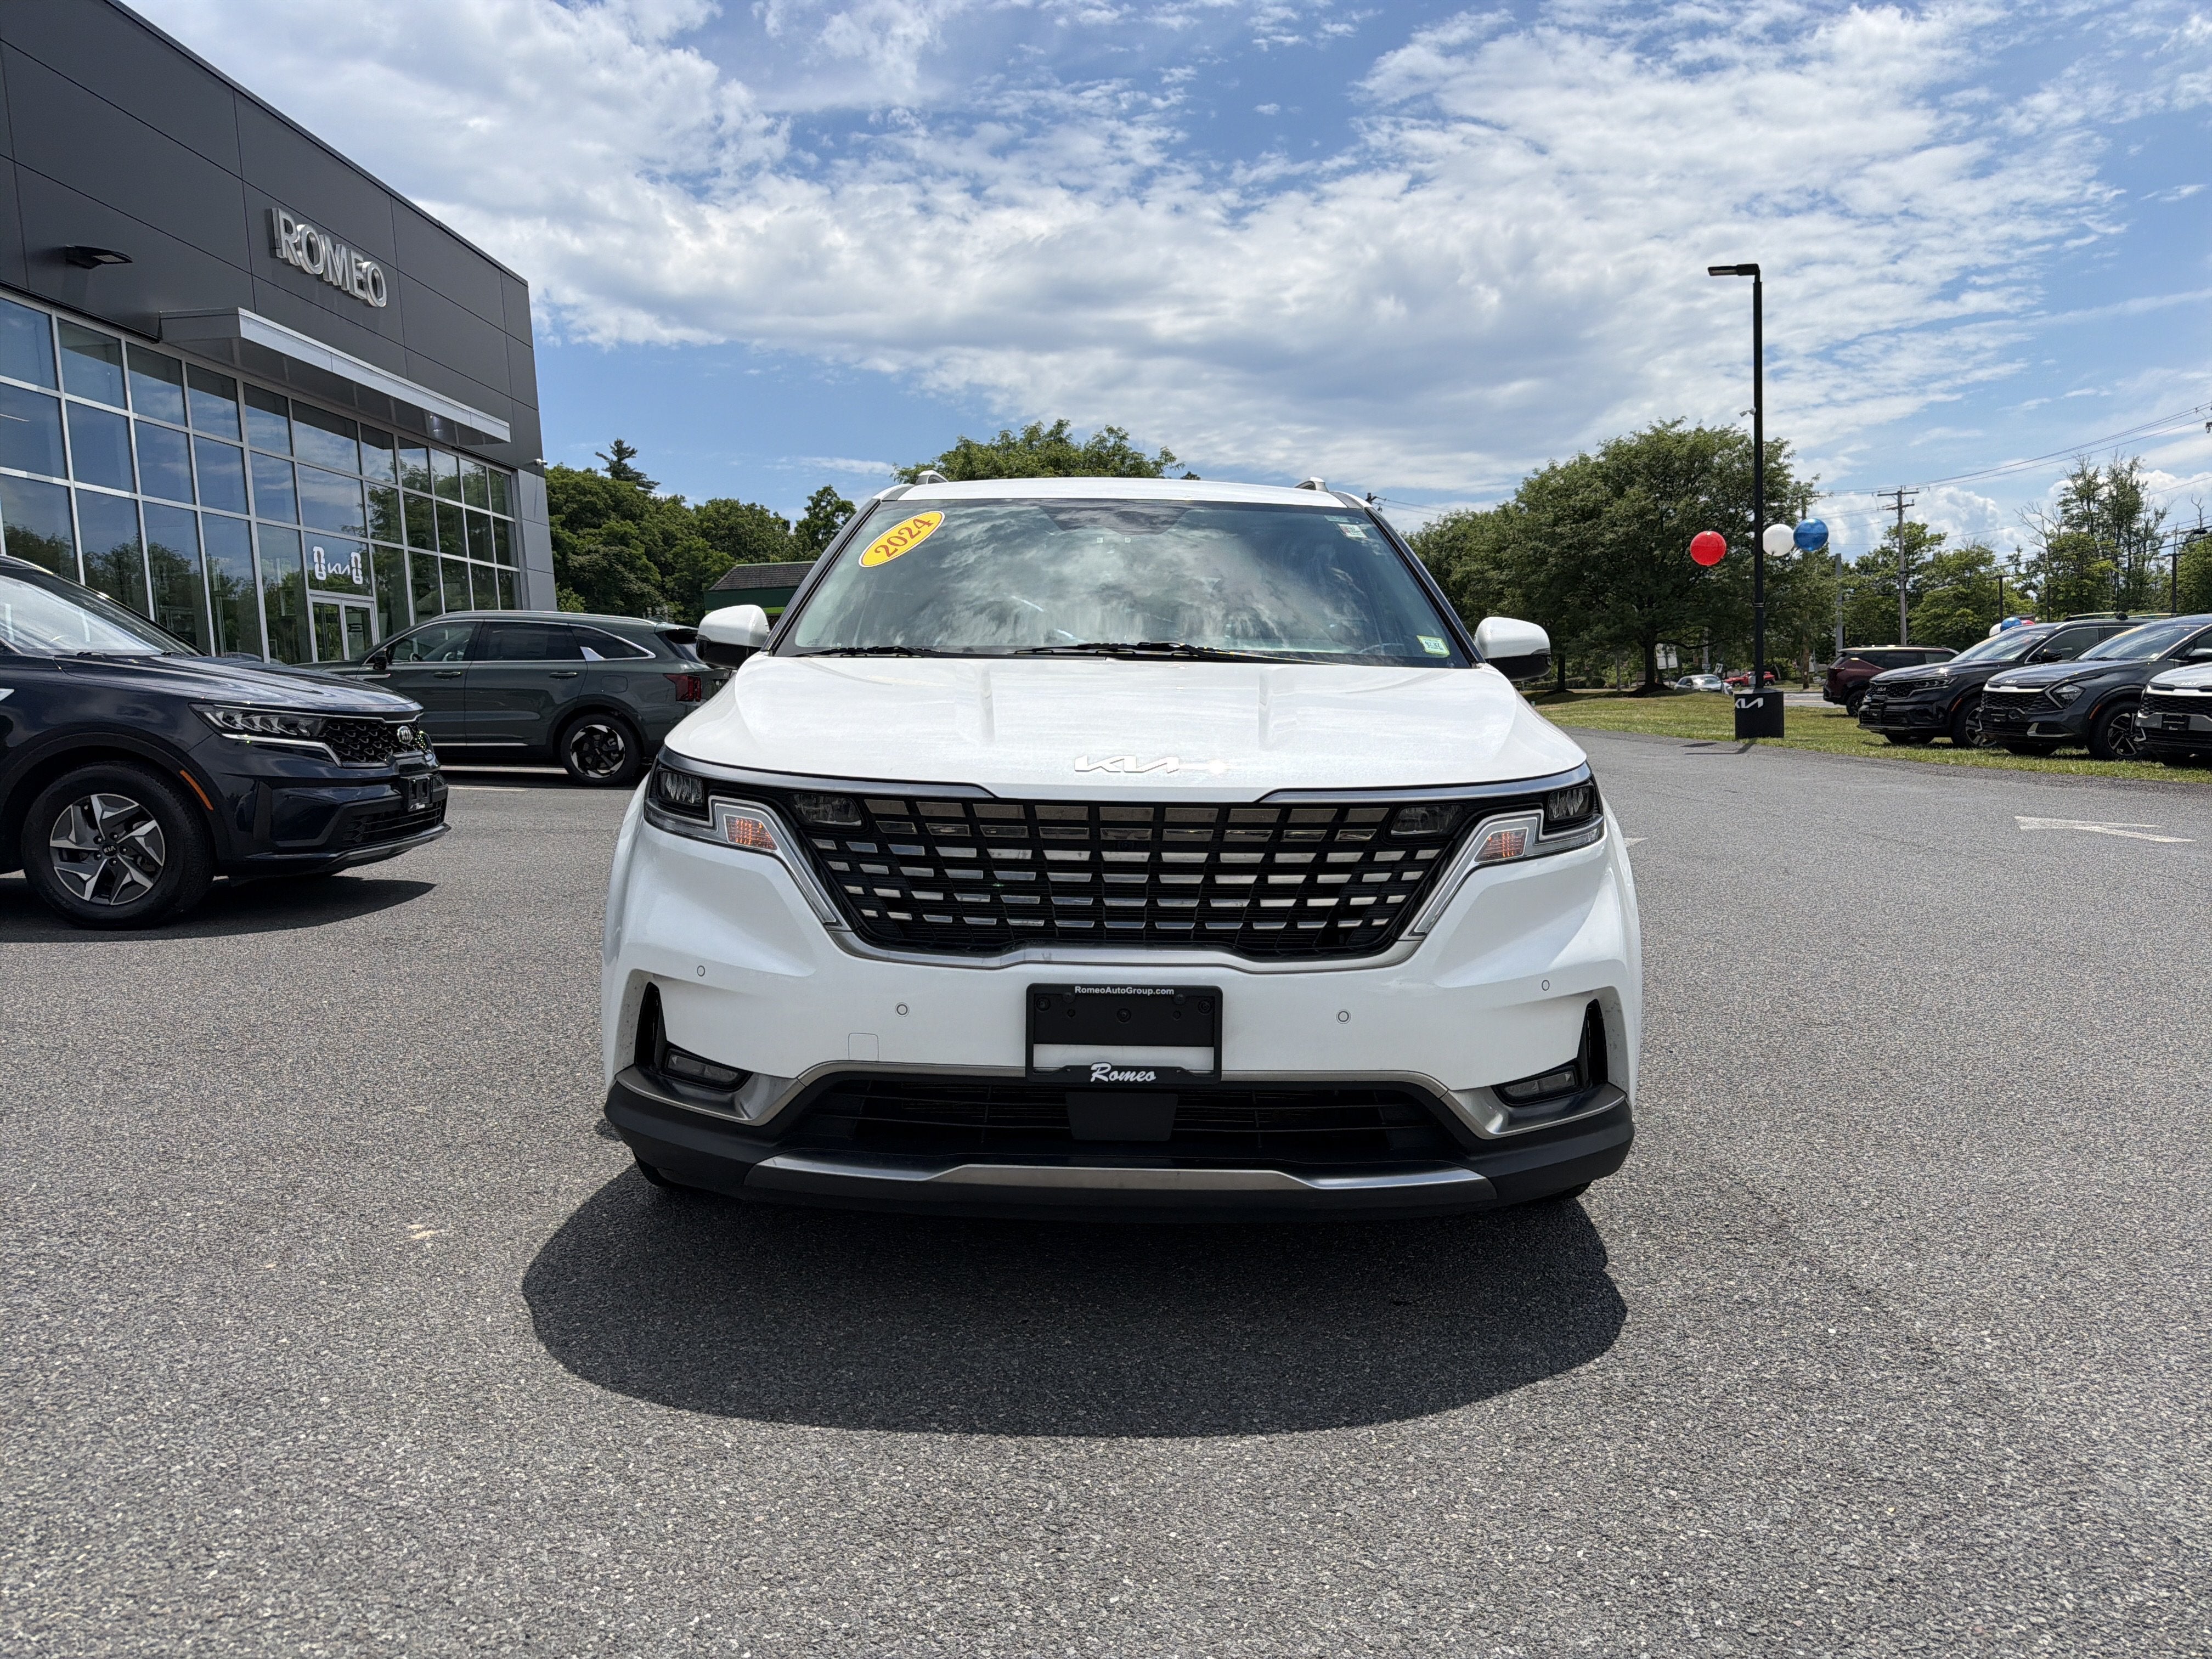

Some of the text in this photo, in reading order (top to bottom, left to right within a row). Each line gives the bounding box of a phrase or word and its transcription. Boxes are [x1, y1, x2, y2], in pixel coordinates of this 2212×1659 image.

[272, 208, 387, 307] ROMEO
[874, 518, 934, 557] 2024
[328, 562, 351, 575] KIA
[402, 730, 411, 740] KIA
[1075, 755, 1180, 774] KIA
[1074, 986, 1175, 996] RomeoAutoGroup.com
[1090, 1062, 1156, 1082] Romeo
